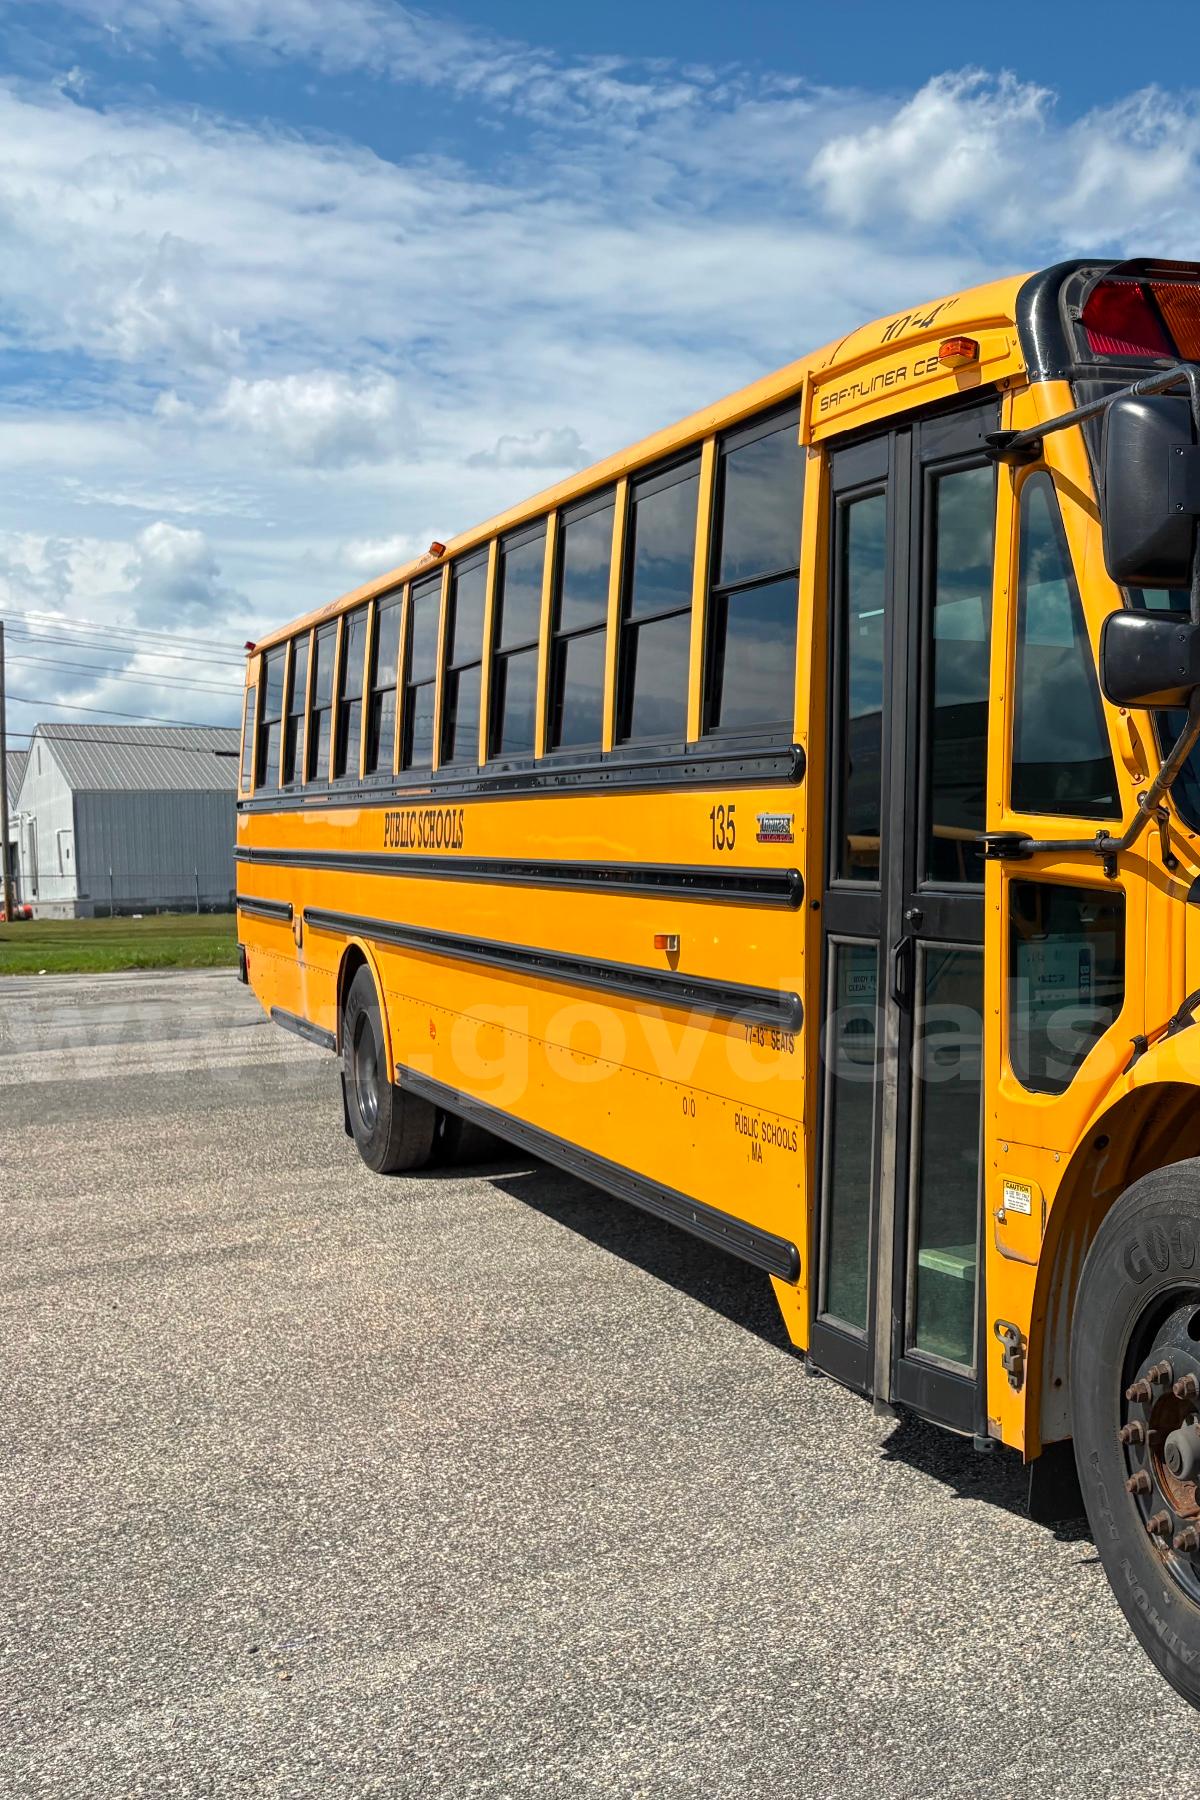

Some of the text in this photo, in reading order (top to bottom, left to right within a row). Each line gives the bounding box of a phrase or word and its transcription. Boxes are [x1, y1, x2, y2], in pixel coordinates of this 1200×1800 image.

[913, 356, 939, 377] C2
[383, 808, 464, 849] PUBLIC SCHOOLS
[709, 804, 736, 851] 135
[771, 1029, 795, 1054] SEATS
[735, 1112, 798, 1153] PUBLIC SCHOOLS
[752, 1141, 763, 1164] MA
